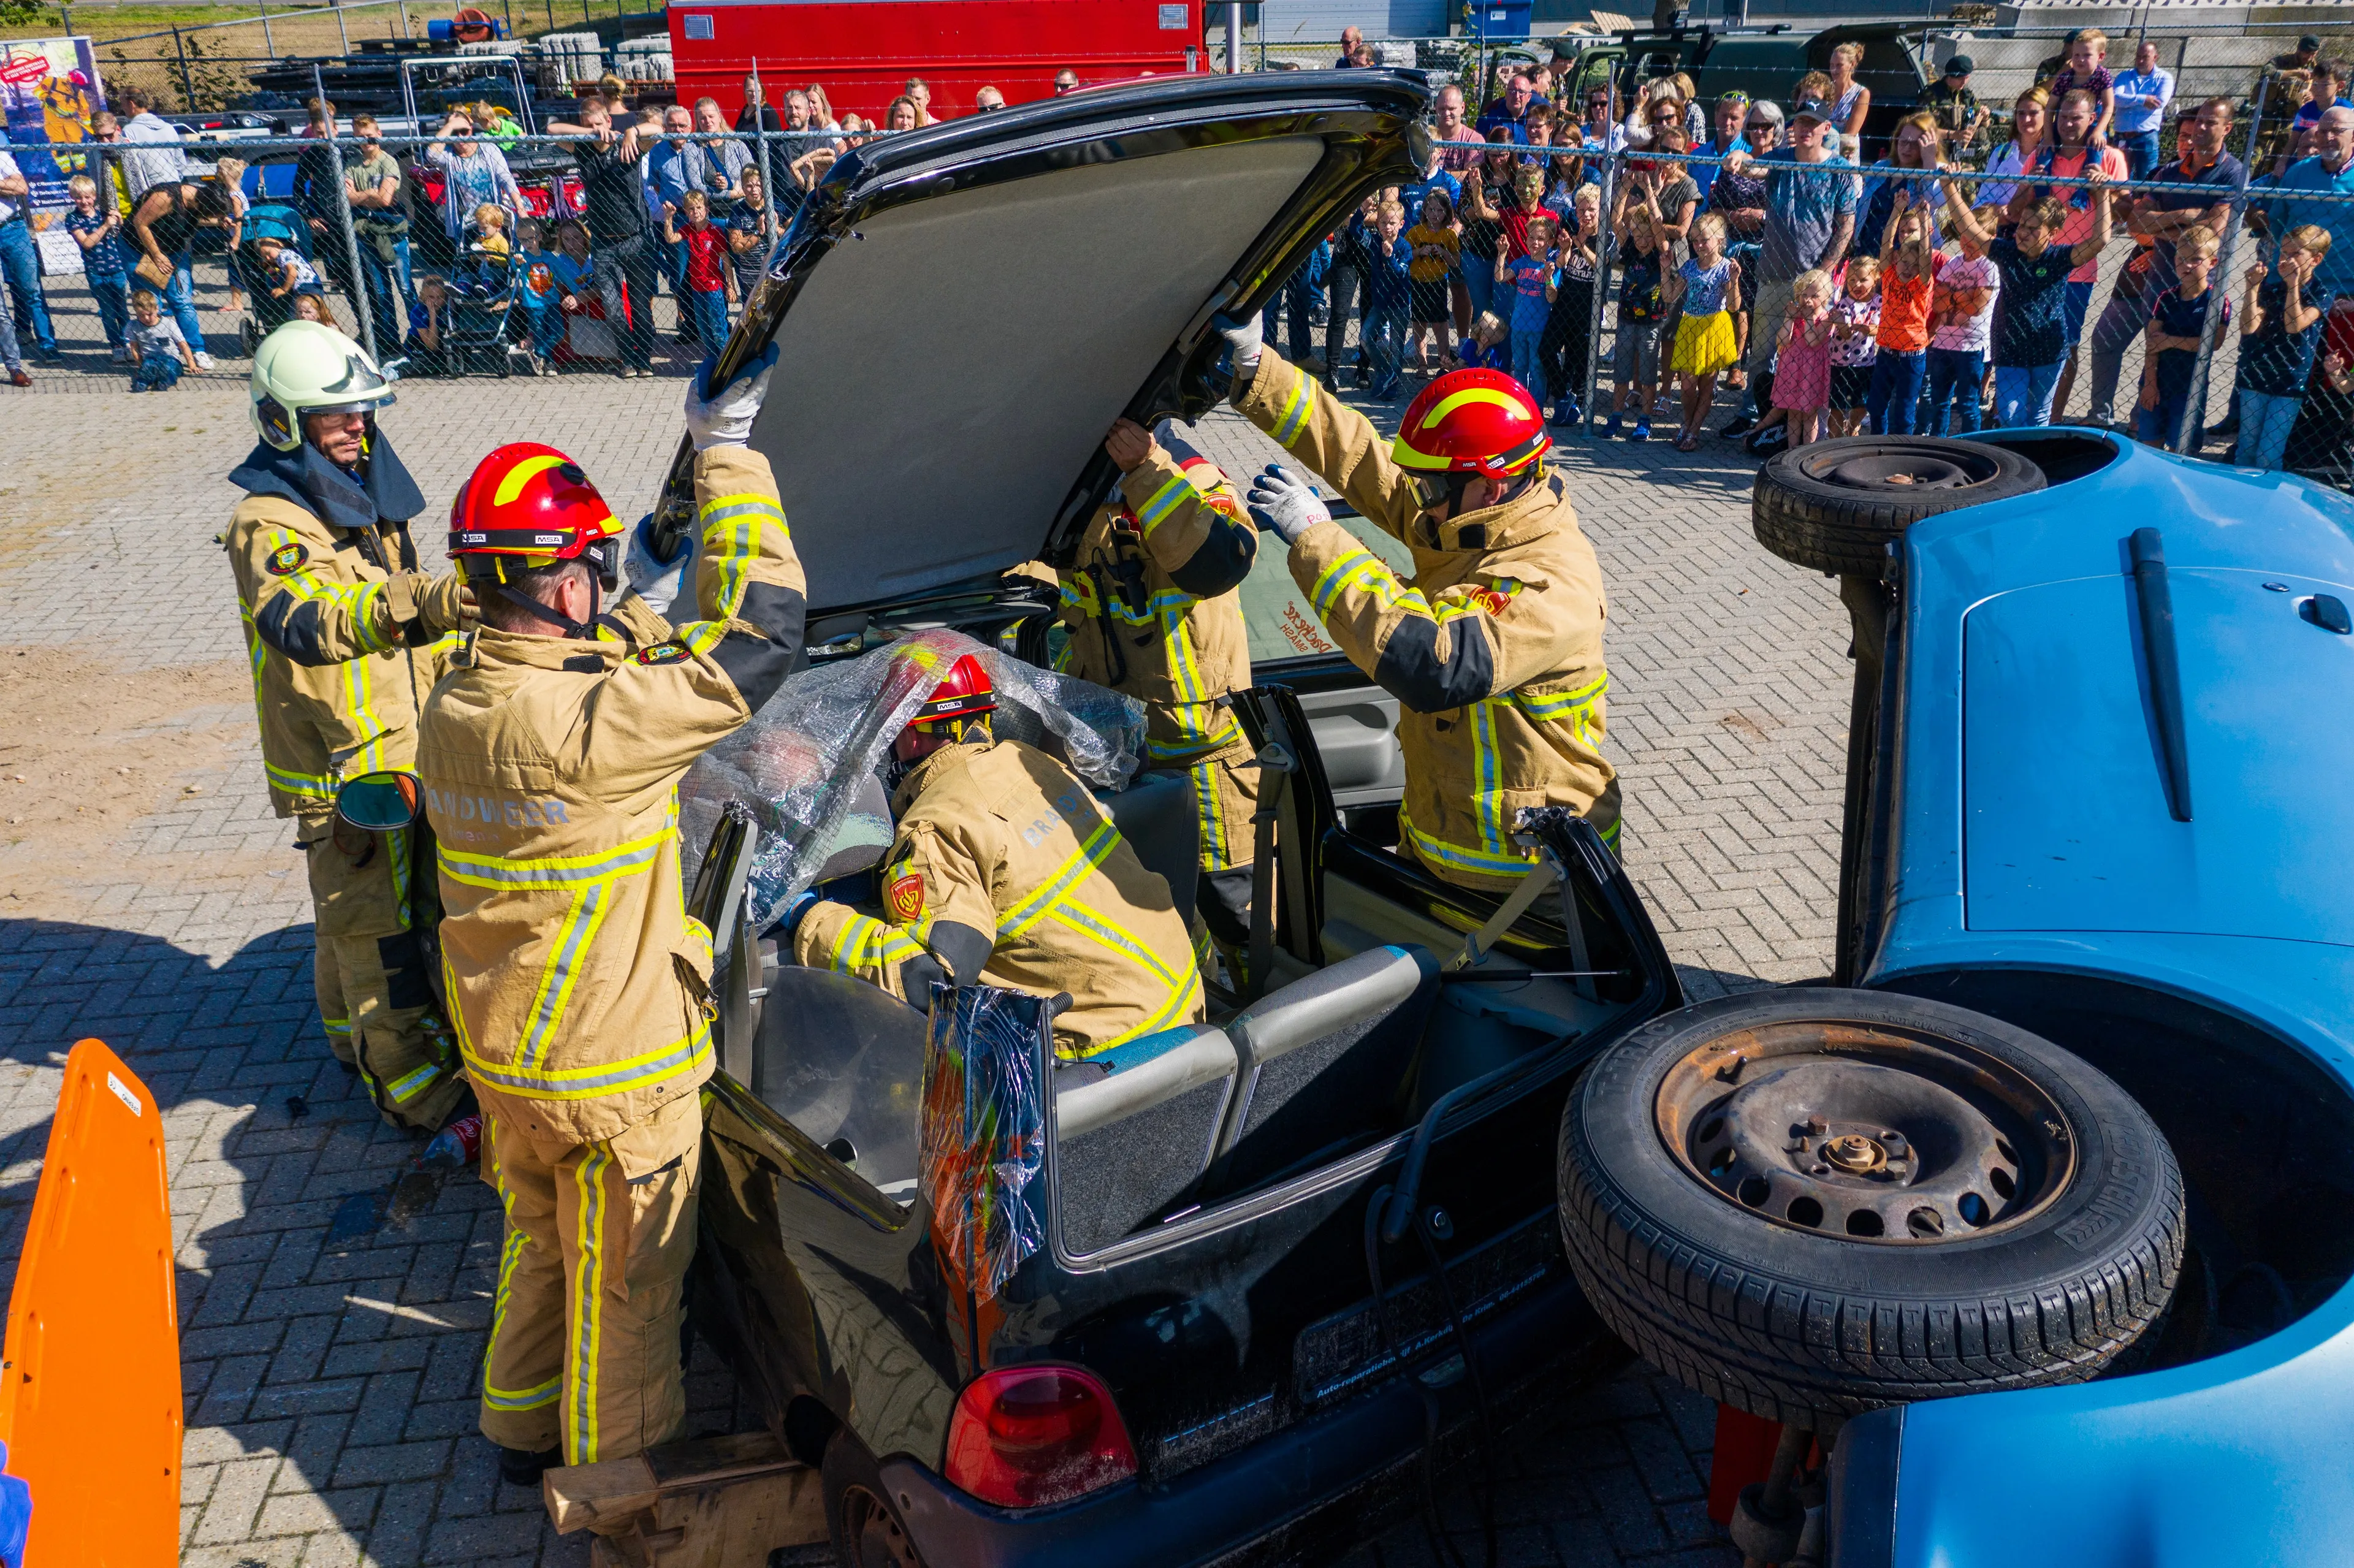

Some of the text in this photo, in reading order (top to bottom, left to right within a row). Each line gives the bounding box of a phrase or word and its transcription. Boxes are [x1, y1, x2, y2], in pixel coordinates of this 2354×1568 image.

[591, 548, 603, 558] MSA
[429, 788, 570, 826] ANDWEER
[1316, 1346, 1411, 1399] Auto-reparatiebeijf
[1415, 1323, 1455, 1351] A.Kerkdij
